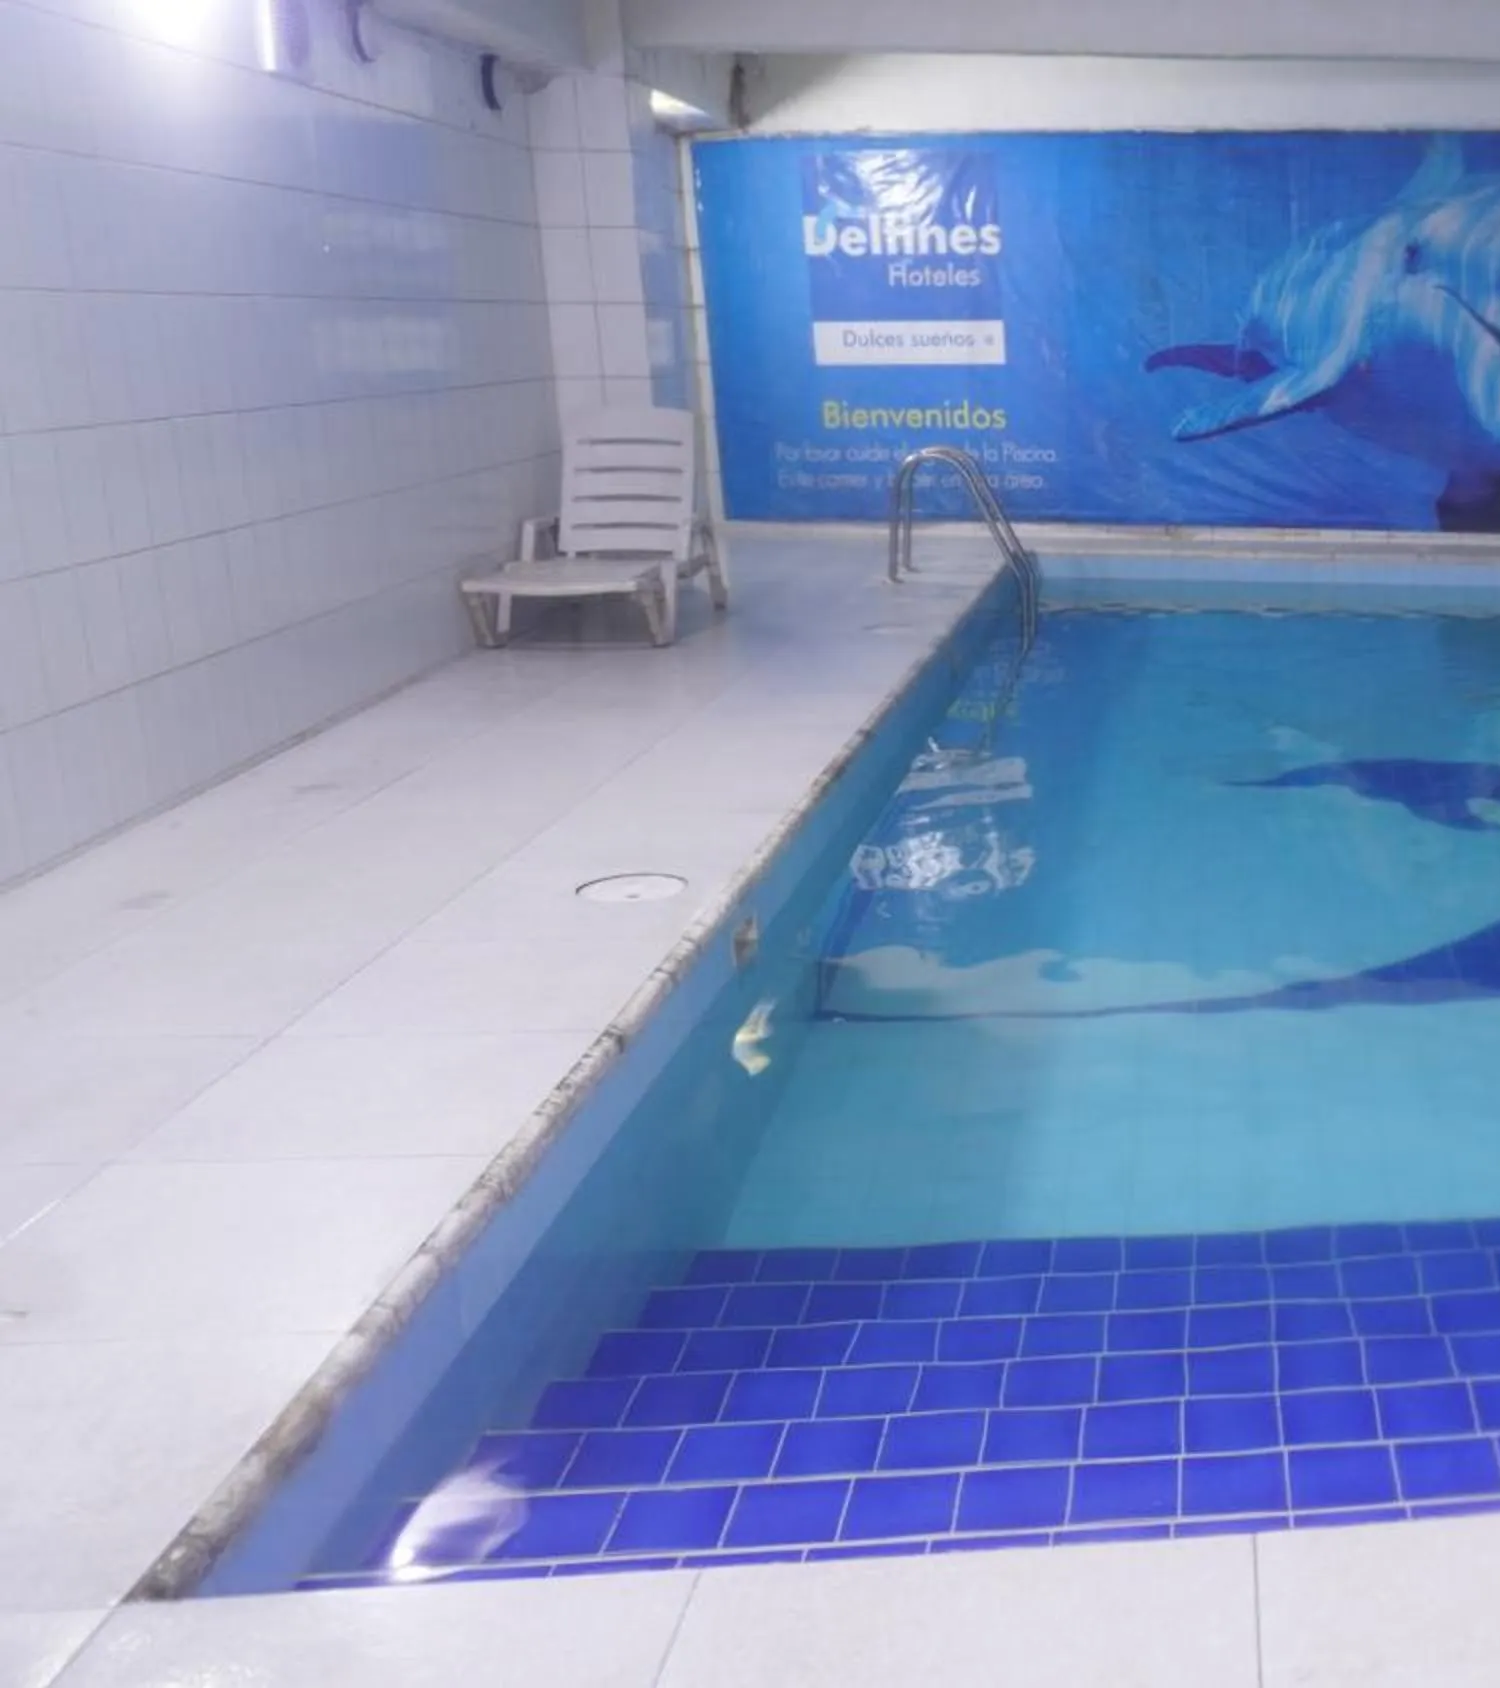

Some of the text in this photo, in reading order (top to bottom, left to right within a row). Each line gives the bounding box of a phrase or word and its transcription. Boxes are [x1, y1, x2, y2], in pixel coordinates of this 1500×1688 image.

[802, 213, 1001, 255] Delfines
[888, 262, 981, 287] Hoteles
[842, 328, 905, 348] Dulces
[823, 399, 1007, 430] Bienvenidos
